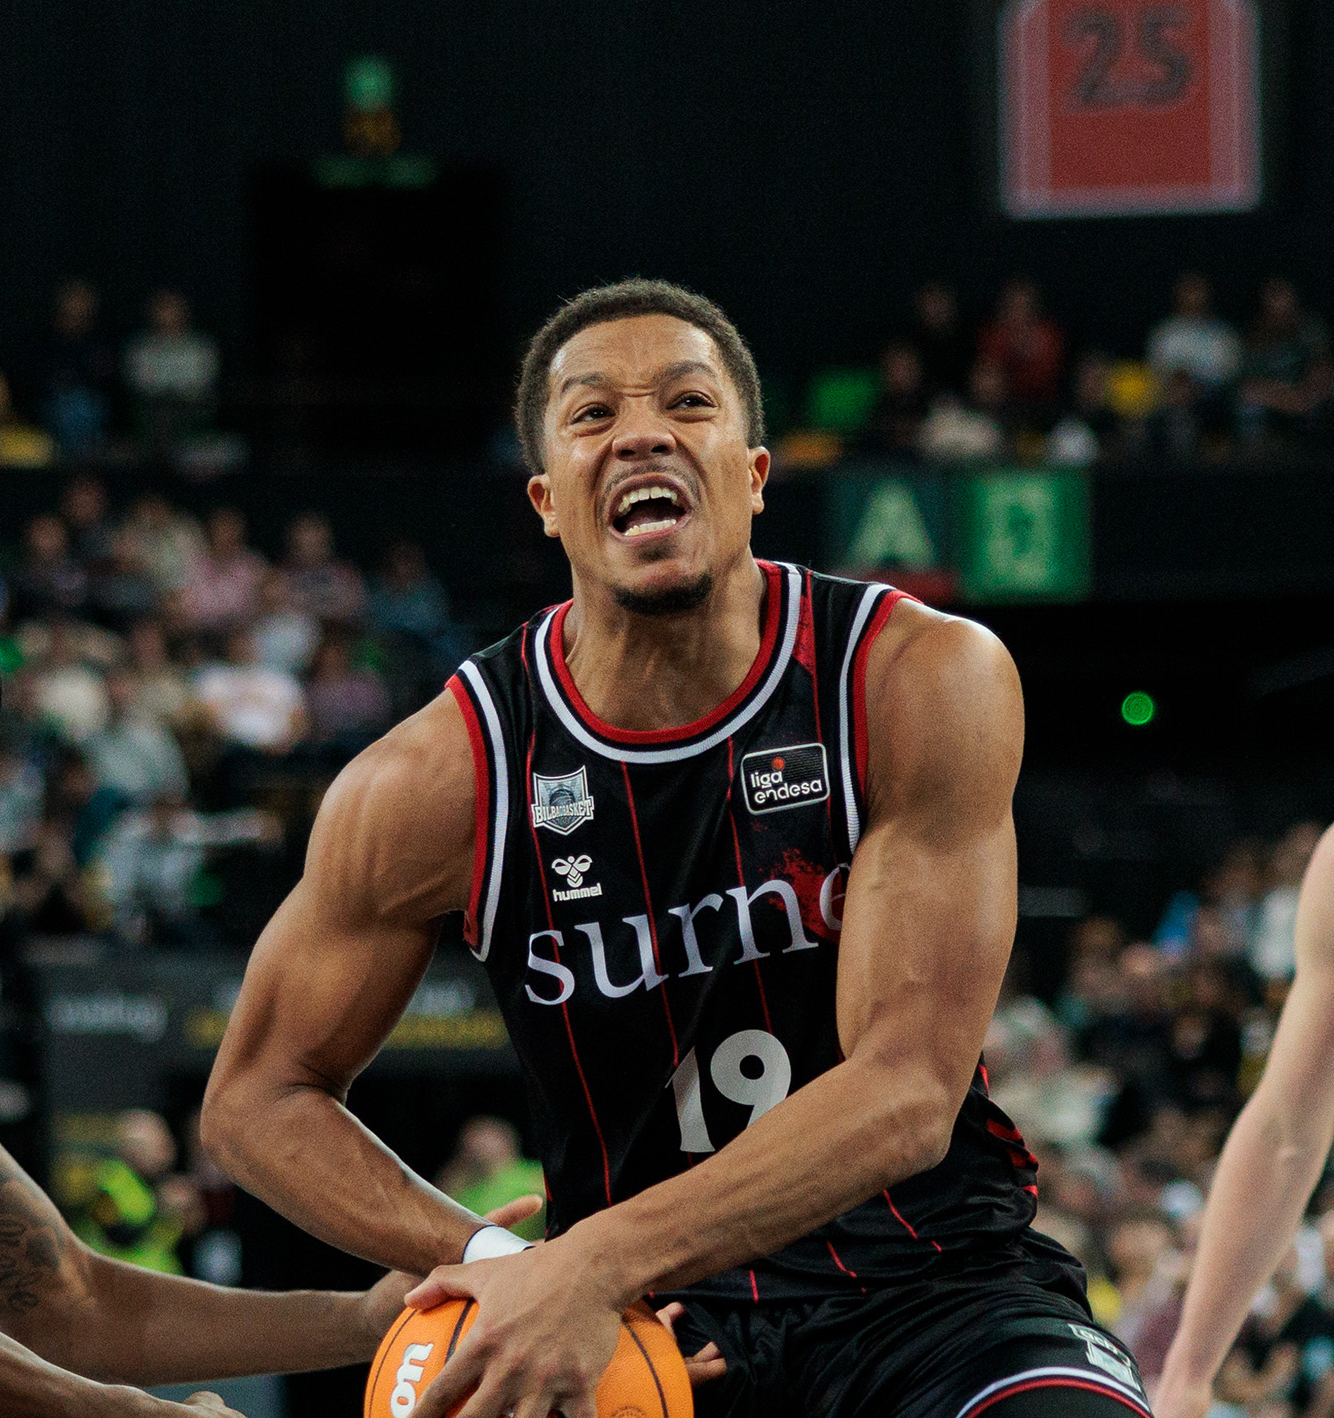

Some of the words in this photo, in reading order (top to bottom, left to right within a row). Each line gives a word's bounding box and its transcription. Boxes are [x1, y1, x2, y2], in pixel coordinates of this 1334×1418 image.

[1064, 5, 1194, 110] 25
[750, 771, 783, 789] liga
[754, 780, 823, 804] endesa
[553, 882, 603, 902] hummel
[665, 1029, 793, 1153] 19
